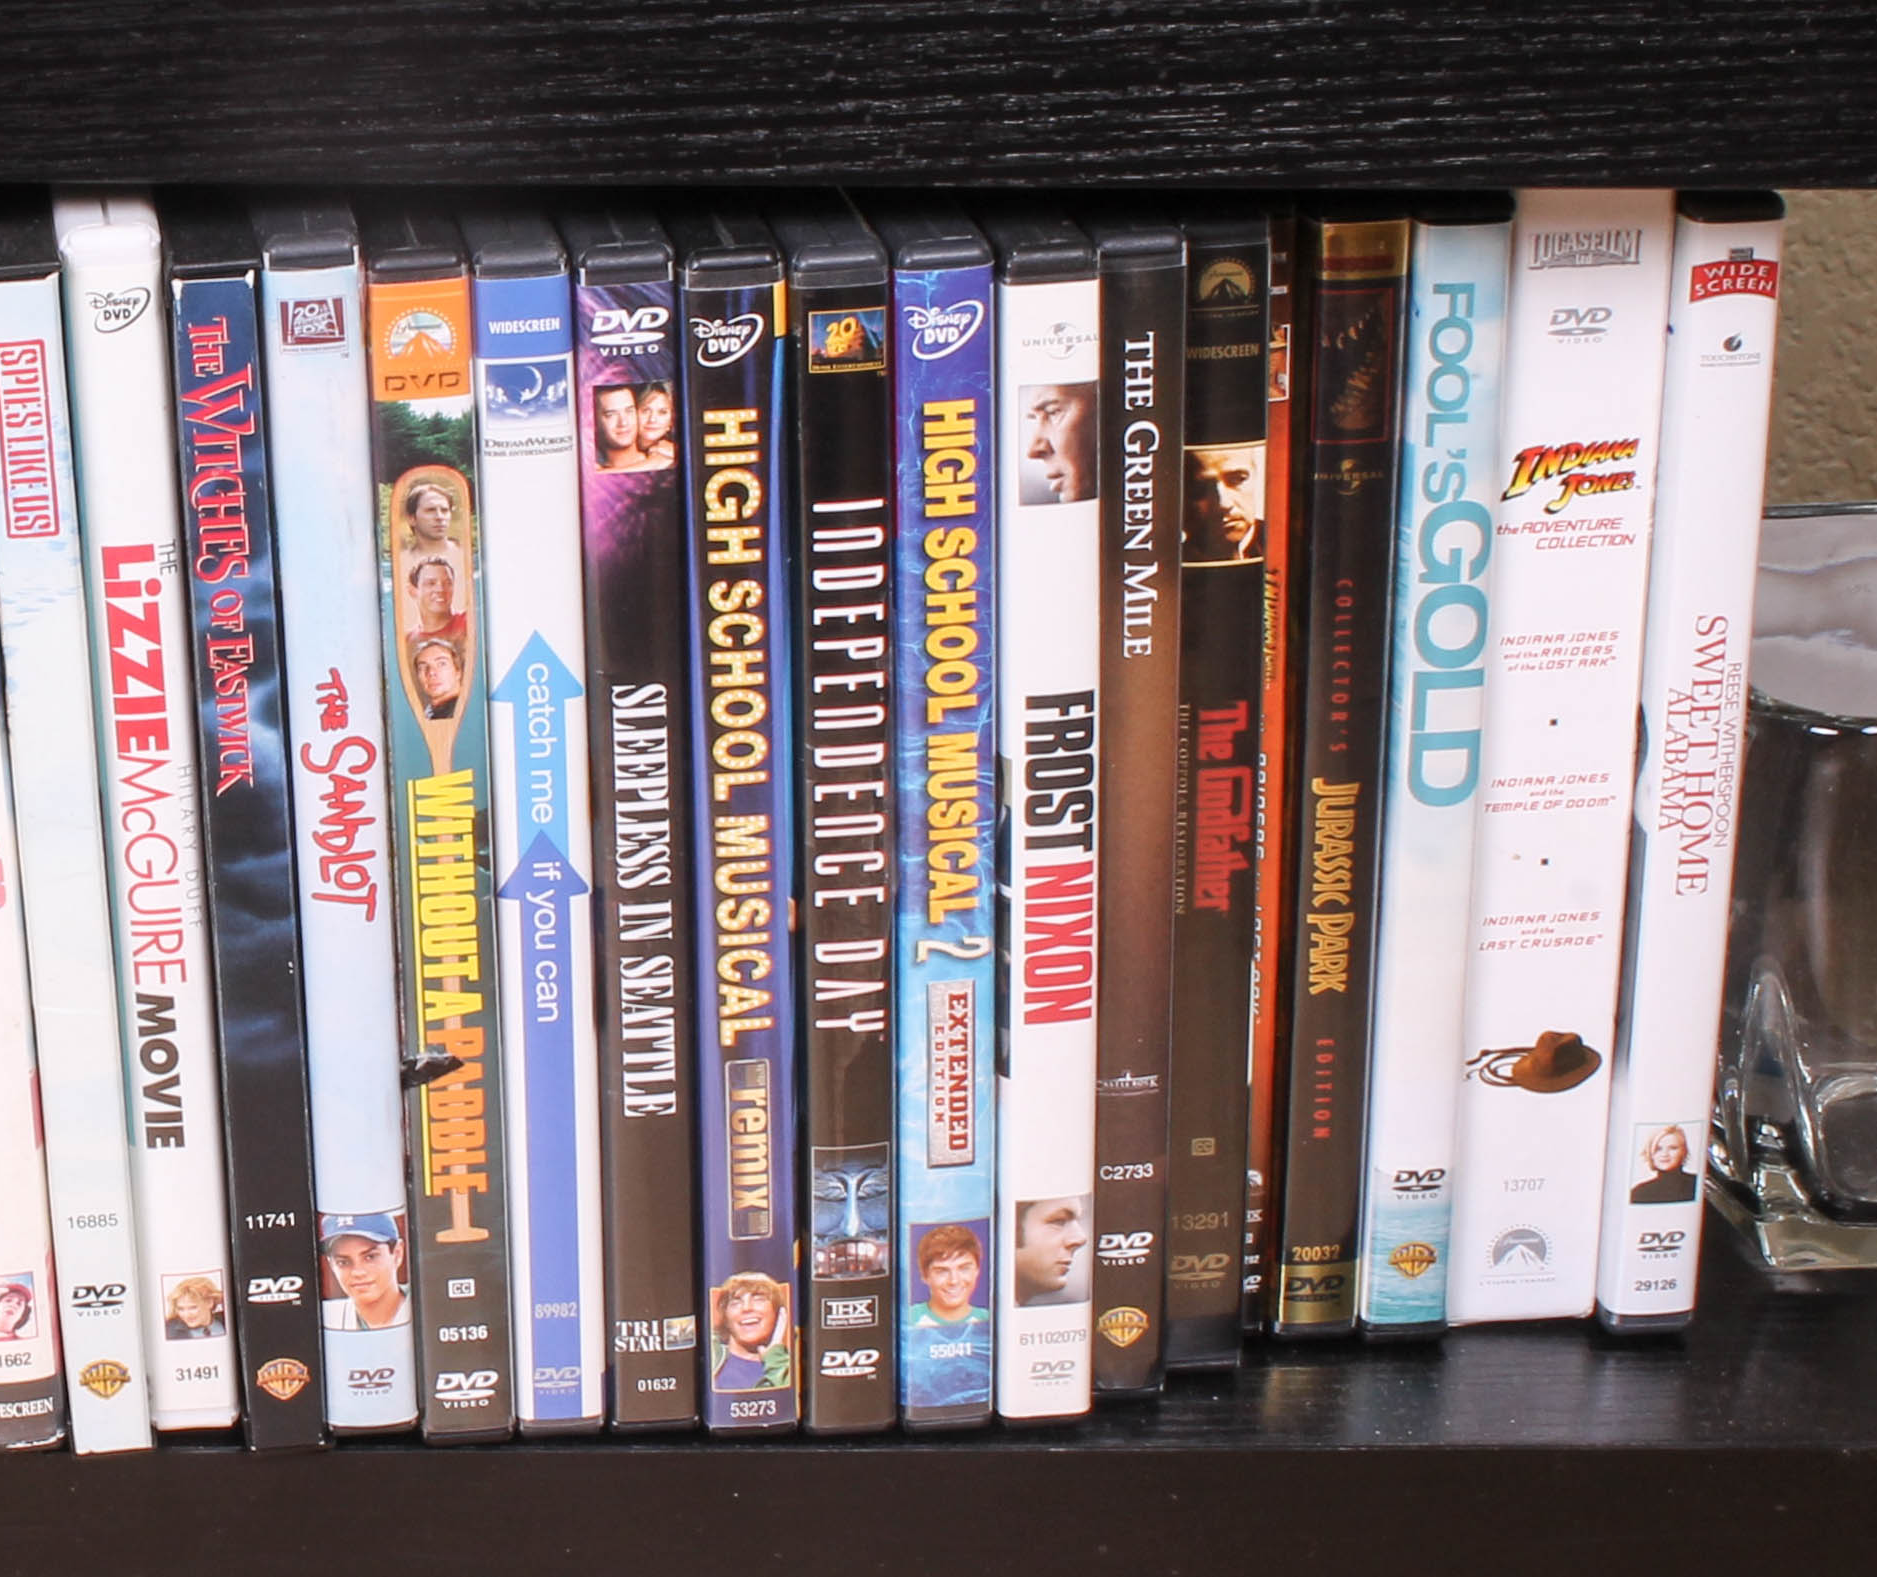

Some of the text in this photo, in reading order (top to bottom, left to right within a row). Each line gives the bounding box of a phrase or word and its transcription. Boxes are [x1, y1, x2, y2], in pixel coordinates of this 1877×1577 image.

[1694, 277, 1775, 297] SCREEN
[1703, 264, 1770, 279] WIDE
[488, 316, 561, 335] WIDESCREEN
[591, 307, 670, 332] DVD
[1186, 342, 1260, 360] WIDESCREEN
[6, 436, 48, 490] LIKE
[1500, 437, 1641, 503] INDIANA
[1544, 470, 1635, 515] JONES
[13, 497, 52, 534] US
[1123, 331, 1161, 660] THE GREEN MILE
[158, 539, 178, 575] THE
[180, 315, 255, 798] THE WITCHES OF EASTWICK
[1406, 281, 1493, 808] FOOL'S GOLD
[1496, 517, 1624, 537] the ADVENTURE
[1535, 533, 1636, 551] COLLECTION
[914, 398, 992, 966] HIGH SCHOOL MUSICAL 2
[1329, 576, 1354, 754] COLLECTOR'S
[702, 408, 775, 1048] HIGH SCHOOL MUSICAL
[1675, 615, 1729, 897] SWEET HOME
[1713, 662, 1742, 849] REESE WITHERSPOON
[811, 498, 888, 1032] INDEPENDENCE DAY
[1658, 687, 1693, 833] ALABAMA
[300, 667, 378, 922] THE SANDLOT
[1193, 700, 1252, 913] The Godfather
[524, 662, 562, 1024] catch me if you can
[1023, 688, 1095, 1026] FROST NIXON
[413, 767, 480, 982] WITHOUT
[611, 682, 677, 1119] SLEEPLESS IN SEATTLE
[1306, 776, 1363, 996] JURASSIC PARK
[423, 990, 483, 1022] A
[134, 991, 186, 1150] MOVIE
[932, 1024, 946, 1124] EDITION
[947, 992, 969, 1151] EXTENDED
[1312, 1037, 1336, 1139] EDITION
[730, 1086, 770, 1211] remix
[1099, 1162, 1154, 1181] C2733
[67, 1213, 119, 1230] 16885
[245, 1212, 296, 1229] 11741
[1291, 1245, 1341, 1262] 20032
[1634, 1278, 1677, 1292] 29126
[439, 1325, 489, 1342] 05136
[614, 1320, 659, 1337] TRI
[614, 1336, 663, 1353] STAR
[175, 1365, 220, 1381] 31491
[637, 1377, 677, 1392] 01632
[729, 1401, 777, 1417] 53273
